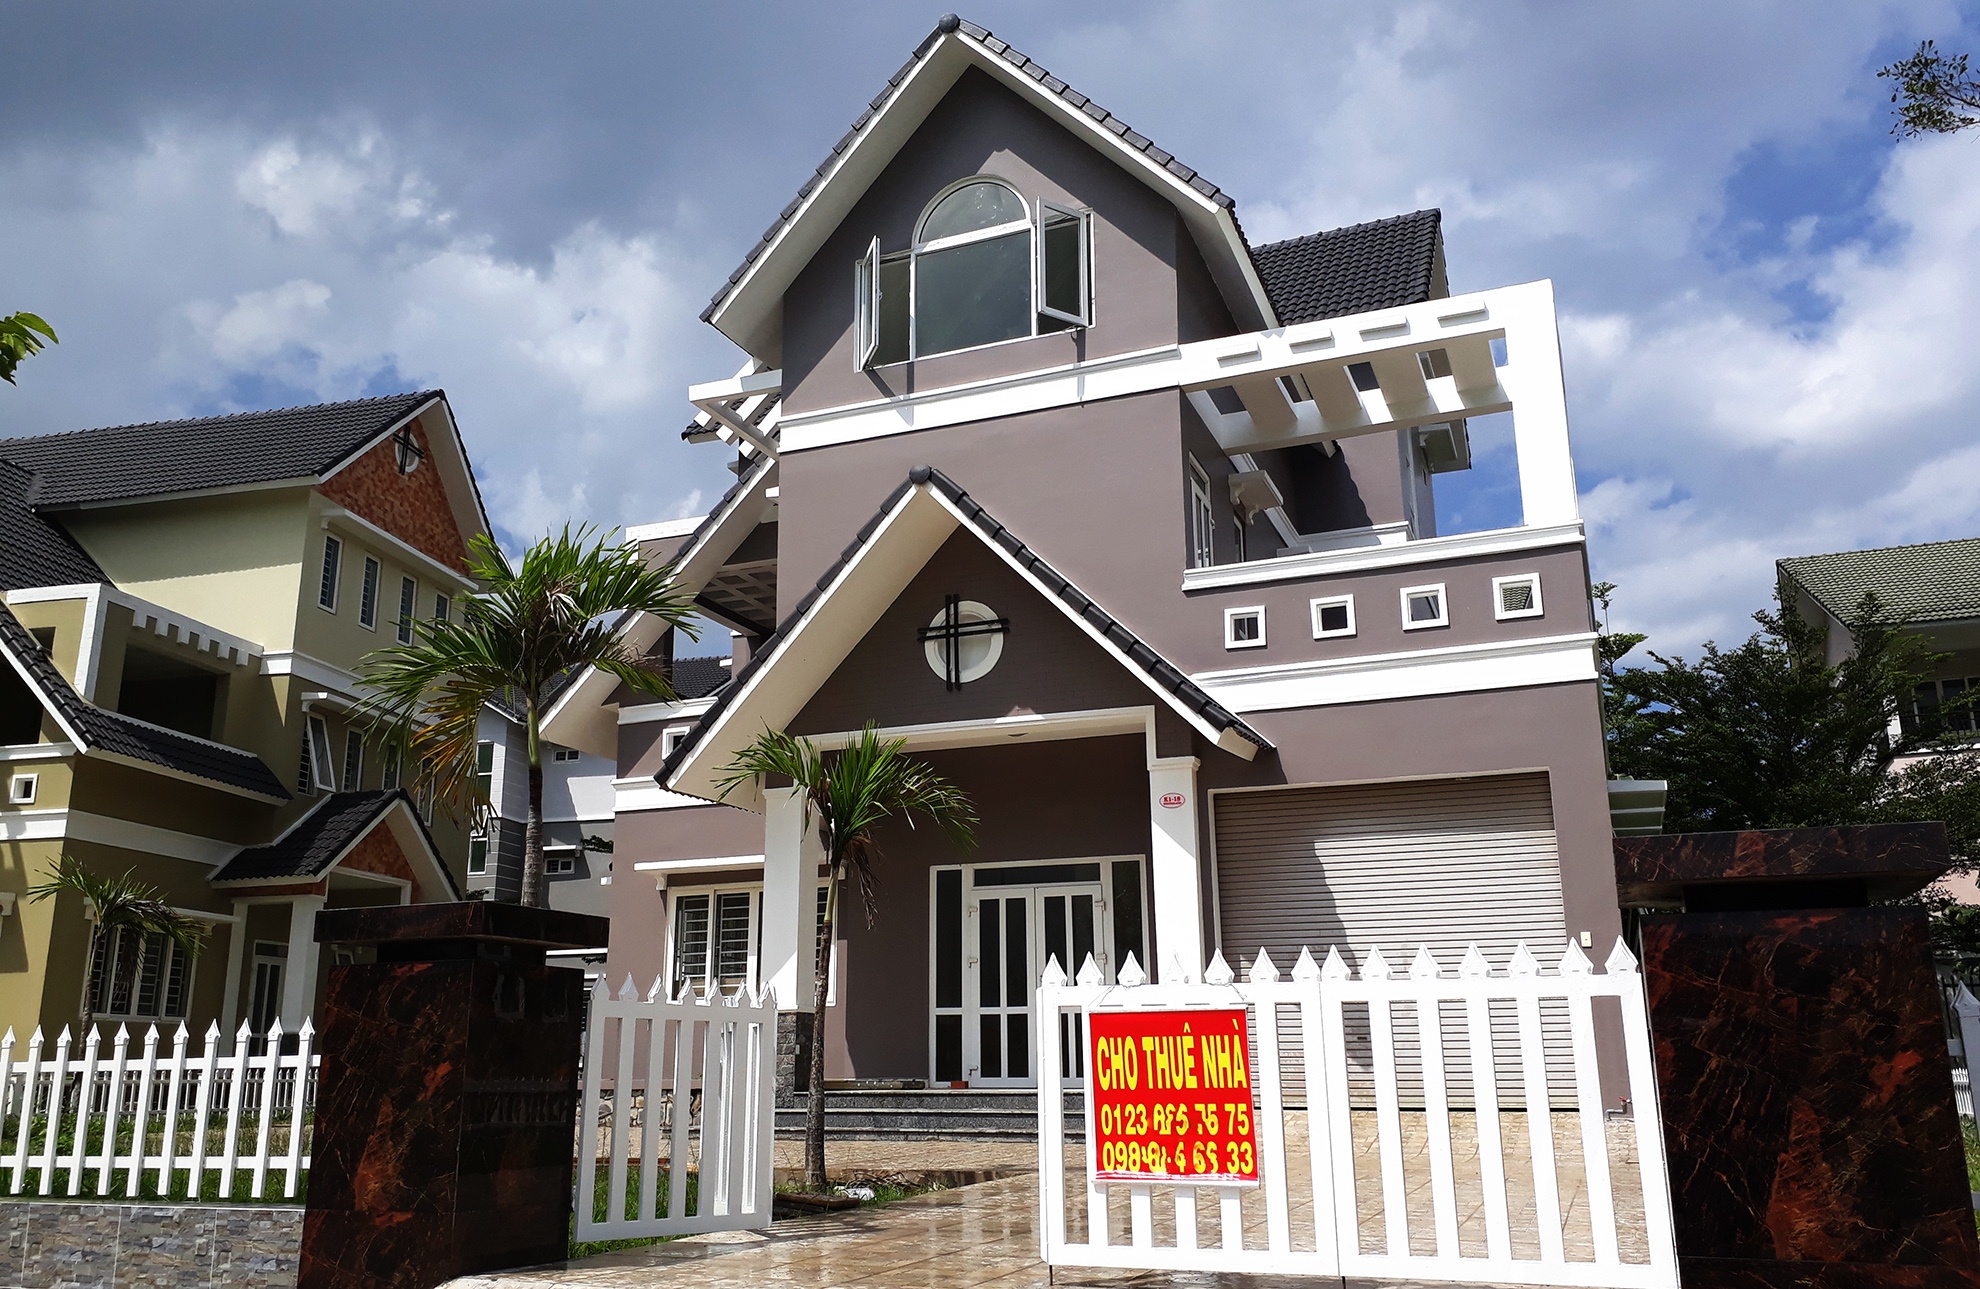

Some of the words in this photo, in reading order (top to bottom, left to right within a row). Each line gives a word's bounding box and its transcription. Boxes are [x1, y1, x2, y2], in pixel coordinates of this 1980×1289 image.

[1096, 1035, 1139, 1091] CHO
[1141, 1021, 1198, 1091] THUÊ
[1200, 1018, 1248, 1090] NHÀ
[1100, 1103, 1149, 1136] 0123
[1223, 1103, 1250, 1136] 75
[1226, 1140, 1254, 1175] 33
